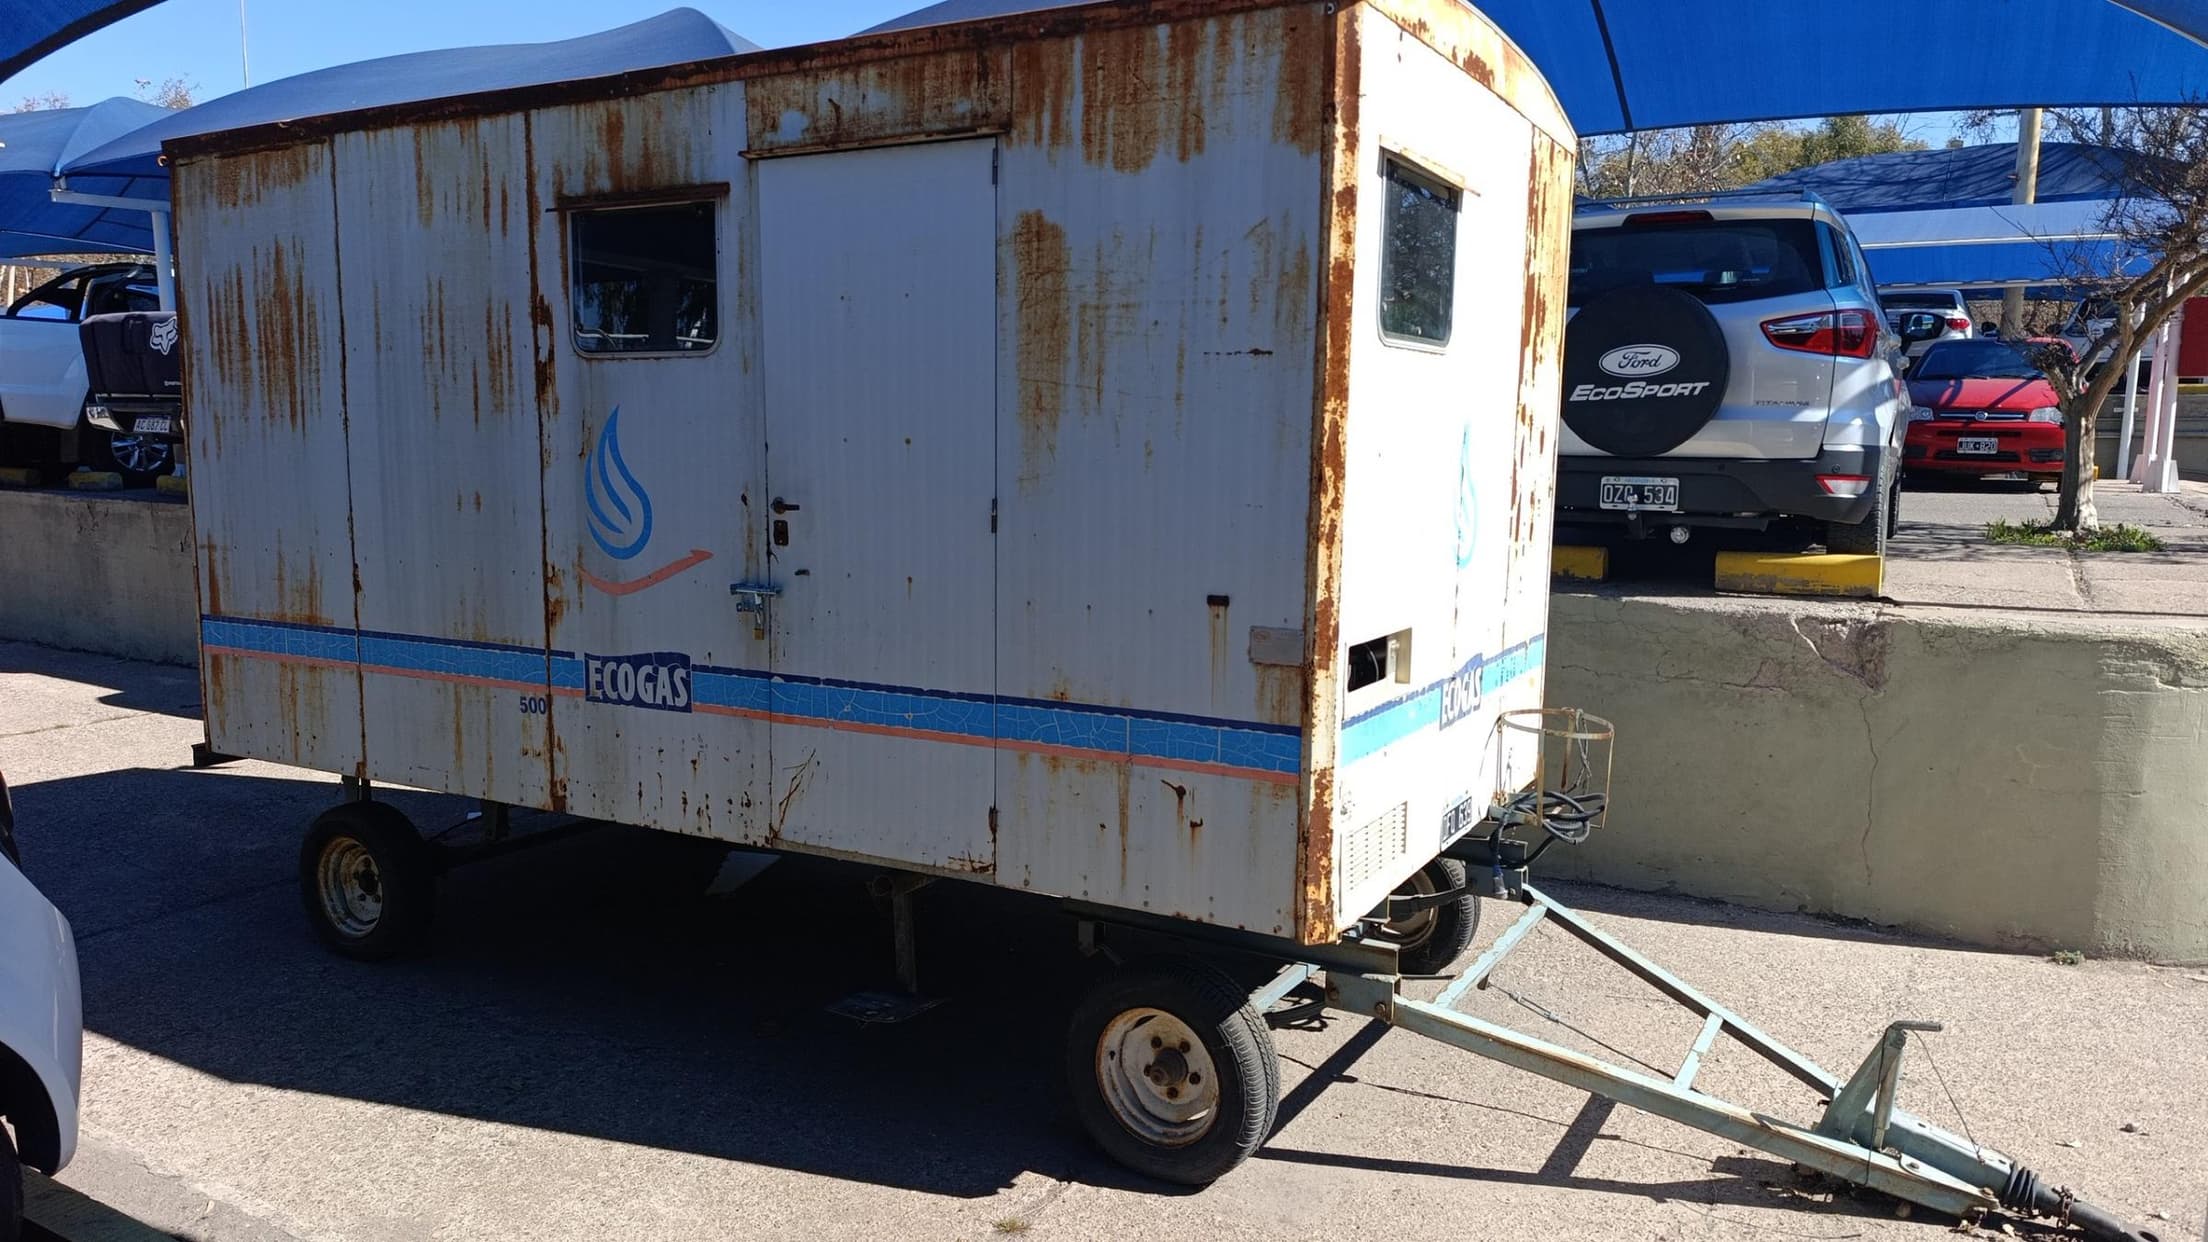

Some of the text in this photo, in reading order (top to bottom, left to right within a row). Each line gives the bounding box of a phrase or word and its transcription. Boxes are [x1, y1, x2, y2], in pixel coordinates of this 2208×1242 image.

[1618, 351, 1662, 369] Ford
[1643, 486, 1675, 504] 534
[588, 659, 688, 708] ECOGAS
[1442, 666, 1482, 724] ECOGAS
[519, 696, 547, 715] 500
